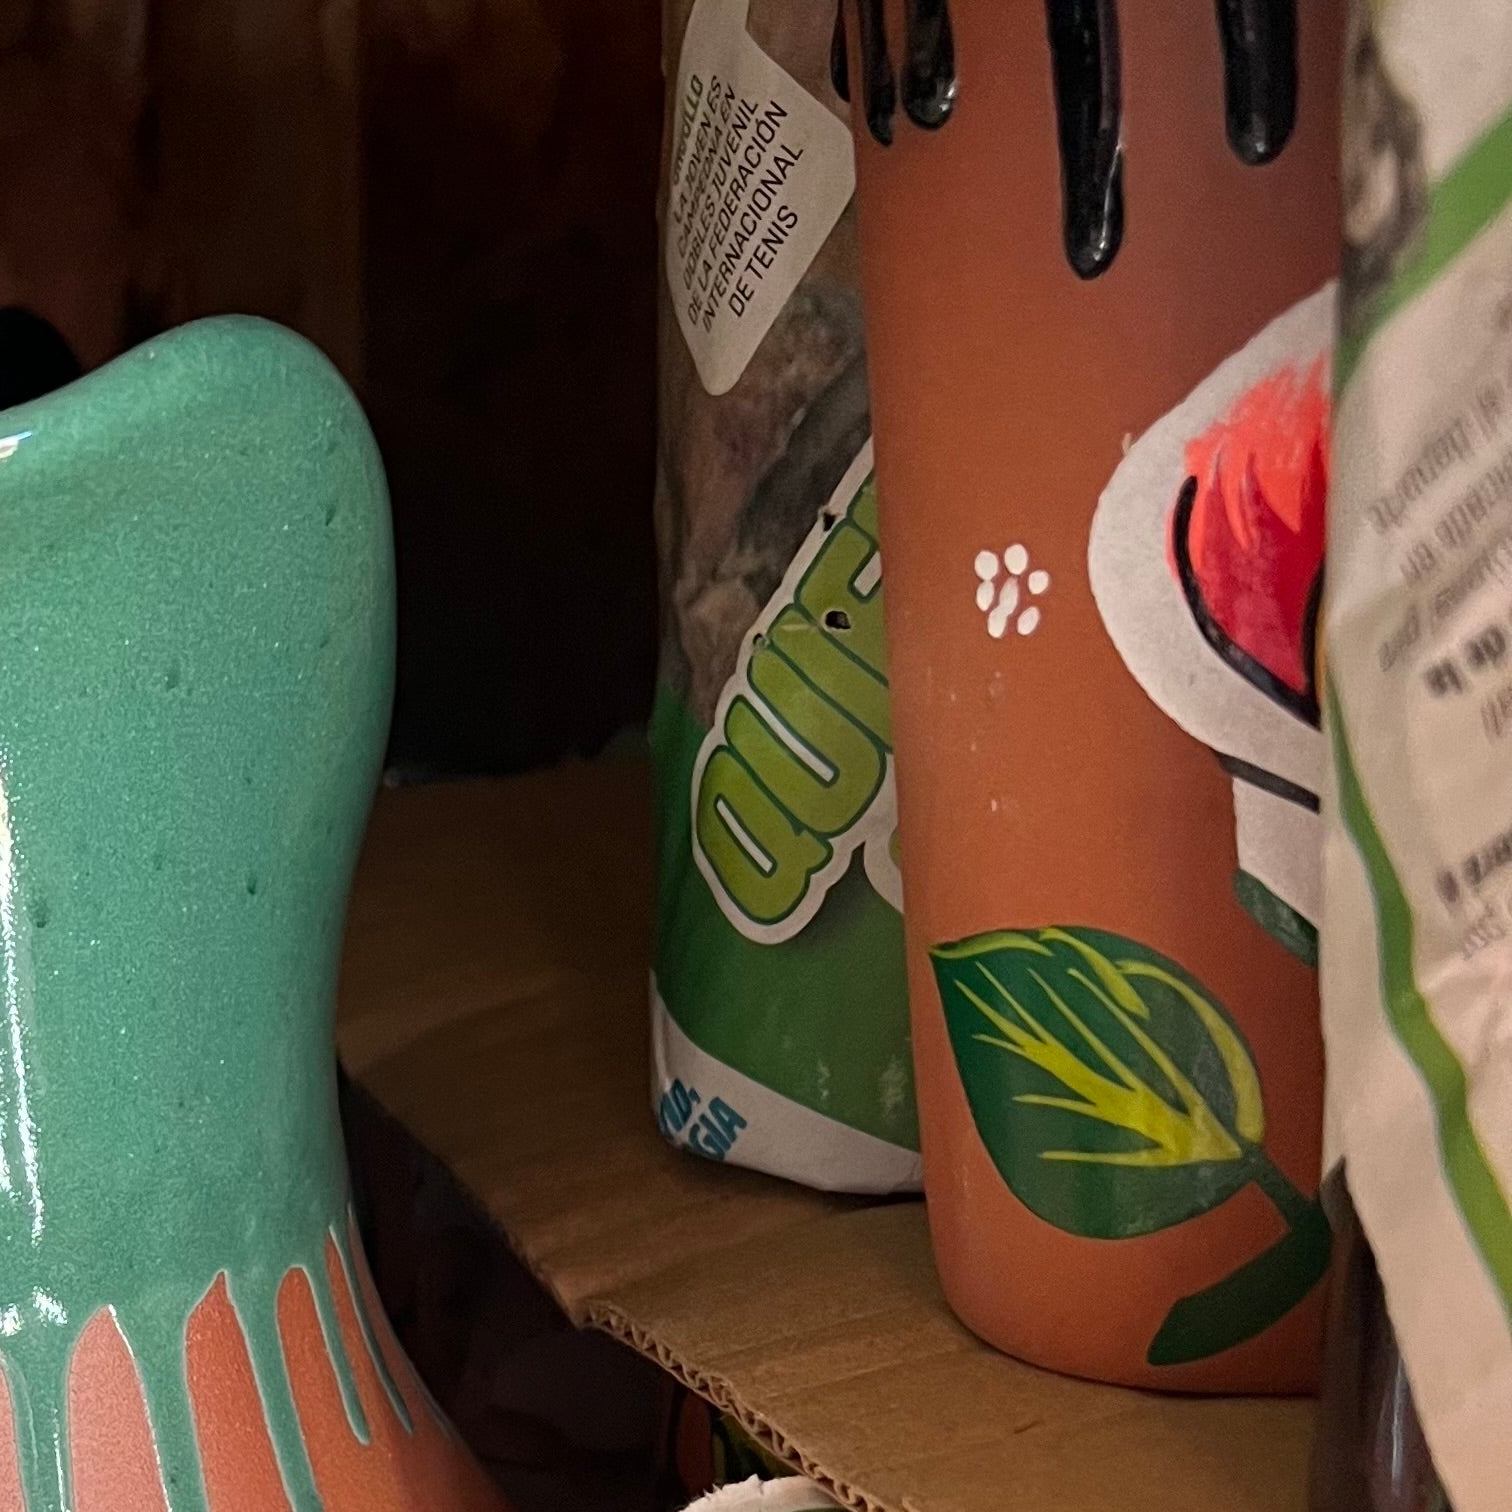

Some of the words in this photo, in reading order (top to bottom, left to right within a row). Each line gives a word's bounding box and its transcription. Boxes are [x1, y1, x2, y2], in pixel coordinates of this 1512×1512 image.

[677, 126, 723, 259] CAMPEONA
[721, 85, 737, 119] EN
[685, 118, 712, 184] JOVEN
[706, 74, 722, 110] ES
[707, 100, 789, 260] FEDERACIÓN
[712, 98, 760, 197] JUVENIL
[700, 147, 804, 333] INTERNACIONAL
[727, 278, 756, 319] DE
[744, 205, 800, 281] TENIS
